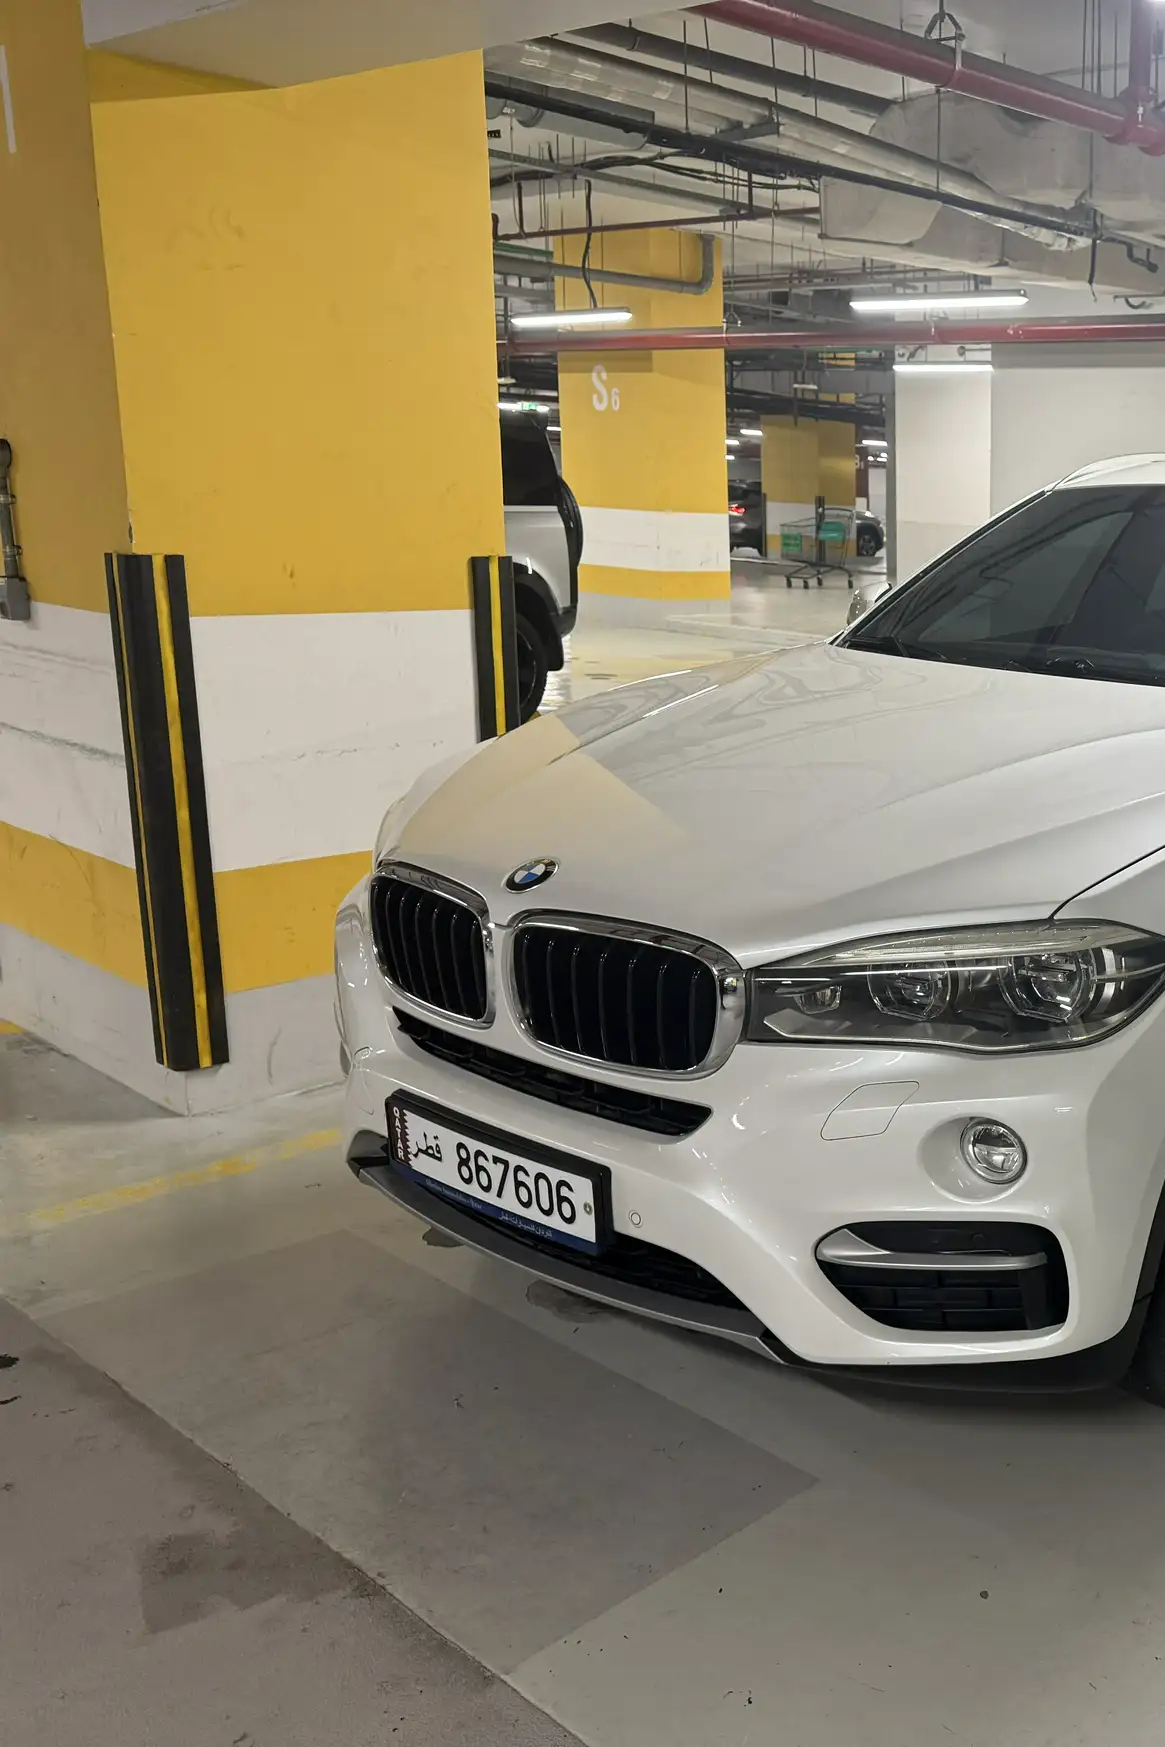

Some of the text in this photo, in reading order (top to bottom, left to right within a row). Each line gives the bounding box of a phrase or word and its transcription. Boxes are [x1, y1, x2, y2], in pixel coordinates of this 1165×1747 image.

[393, 1106, 405, 1160] QATAR
[410, 1131, 443, 1162] قطر
[456, 1142, 577, 1225] 867606
